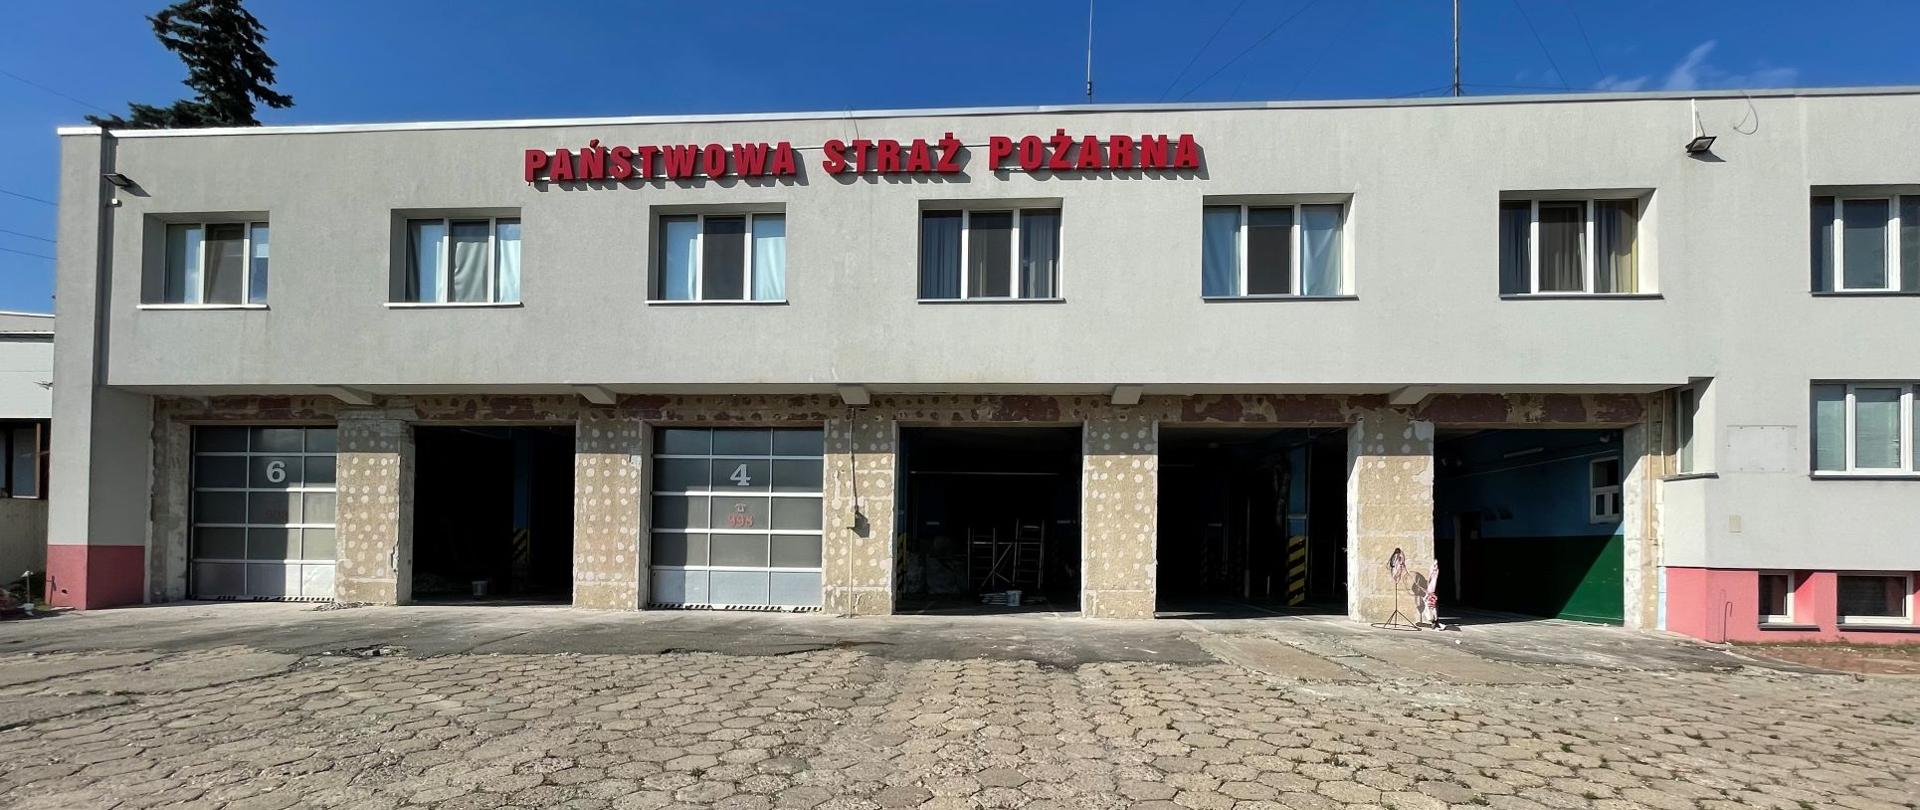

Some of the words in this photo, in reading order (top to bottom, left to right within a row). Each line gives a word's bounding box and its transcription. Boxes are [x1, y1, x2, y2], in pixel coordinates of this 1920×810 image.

[524, 138, 797, 182] PAŃSTWOWA
[822, 131, 961, 175] STRAŻ
[988, 128, 1199, 171] POŻARNA
[266, 460, 286, 483] 6
[730, 463, 751, 486] 4
